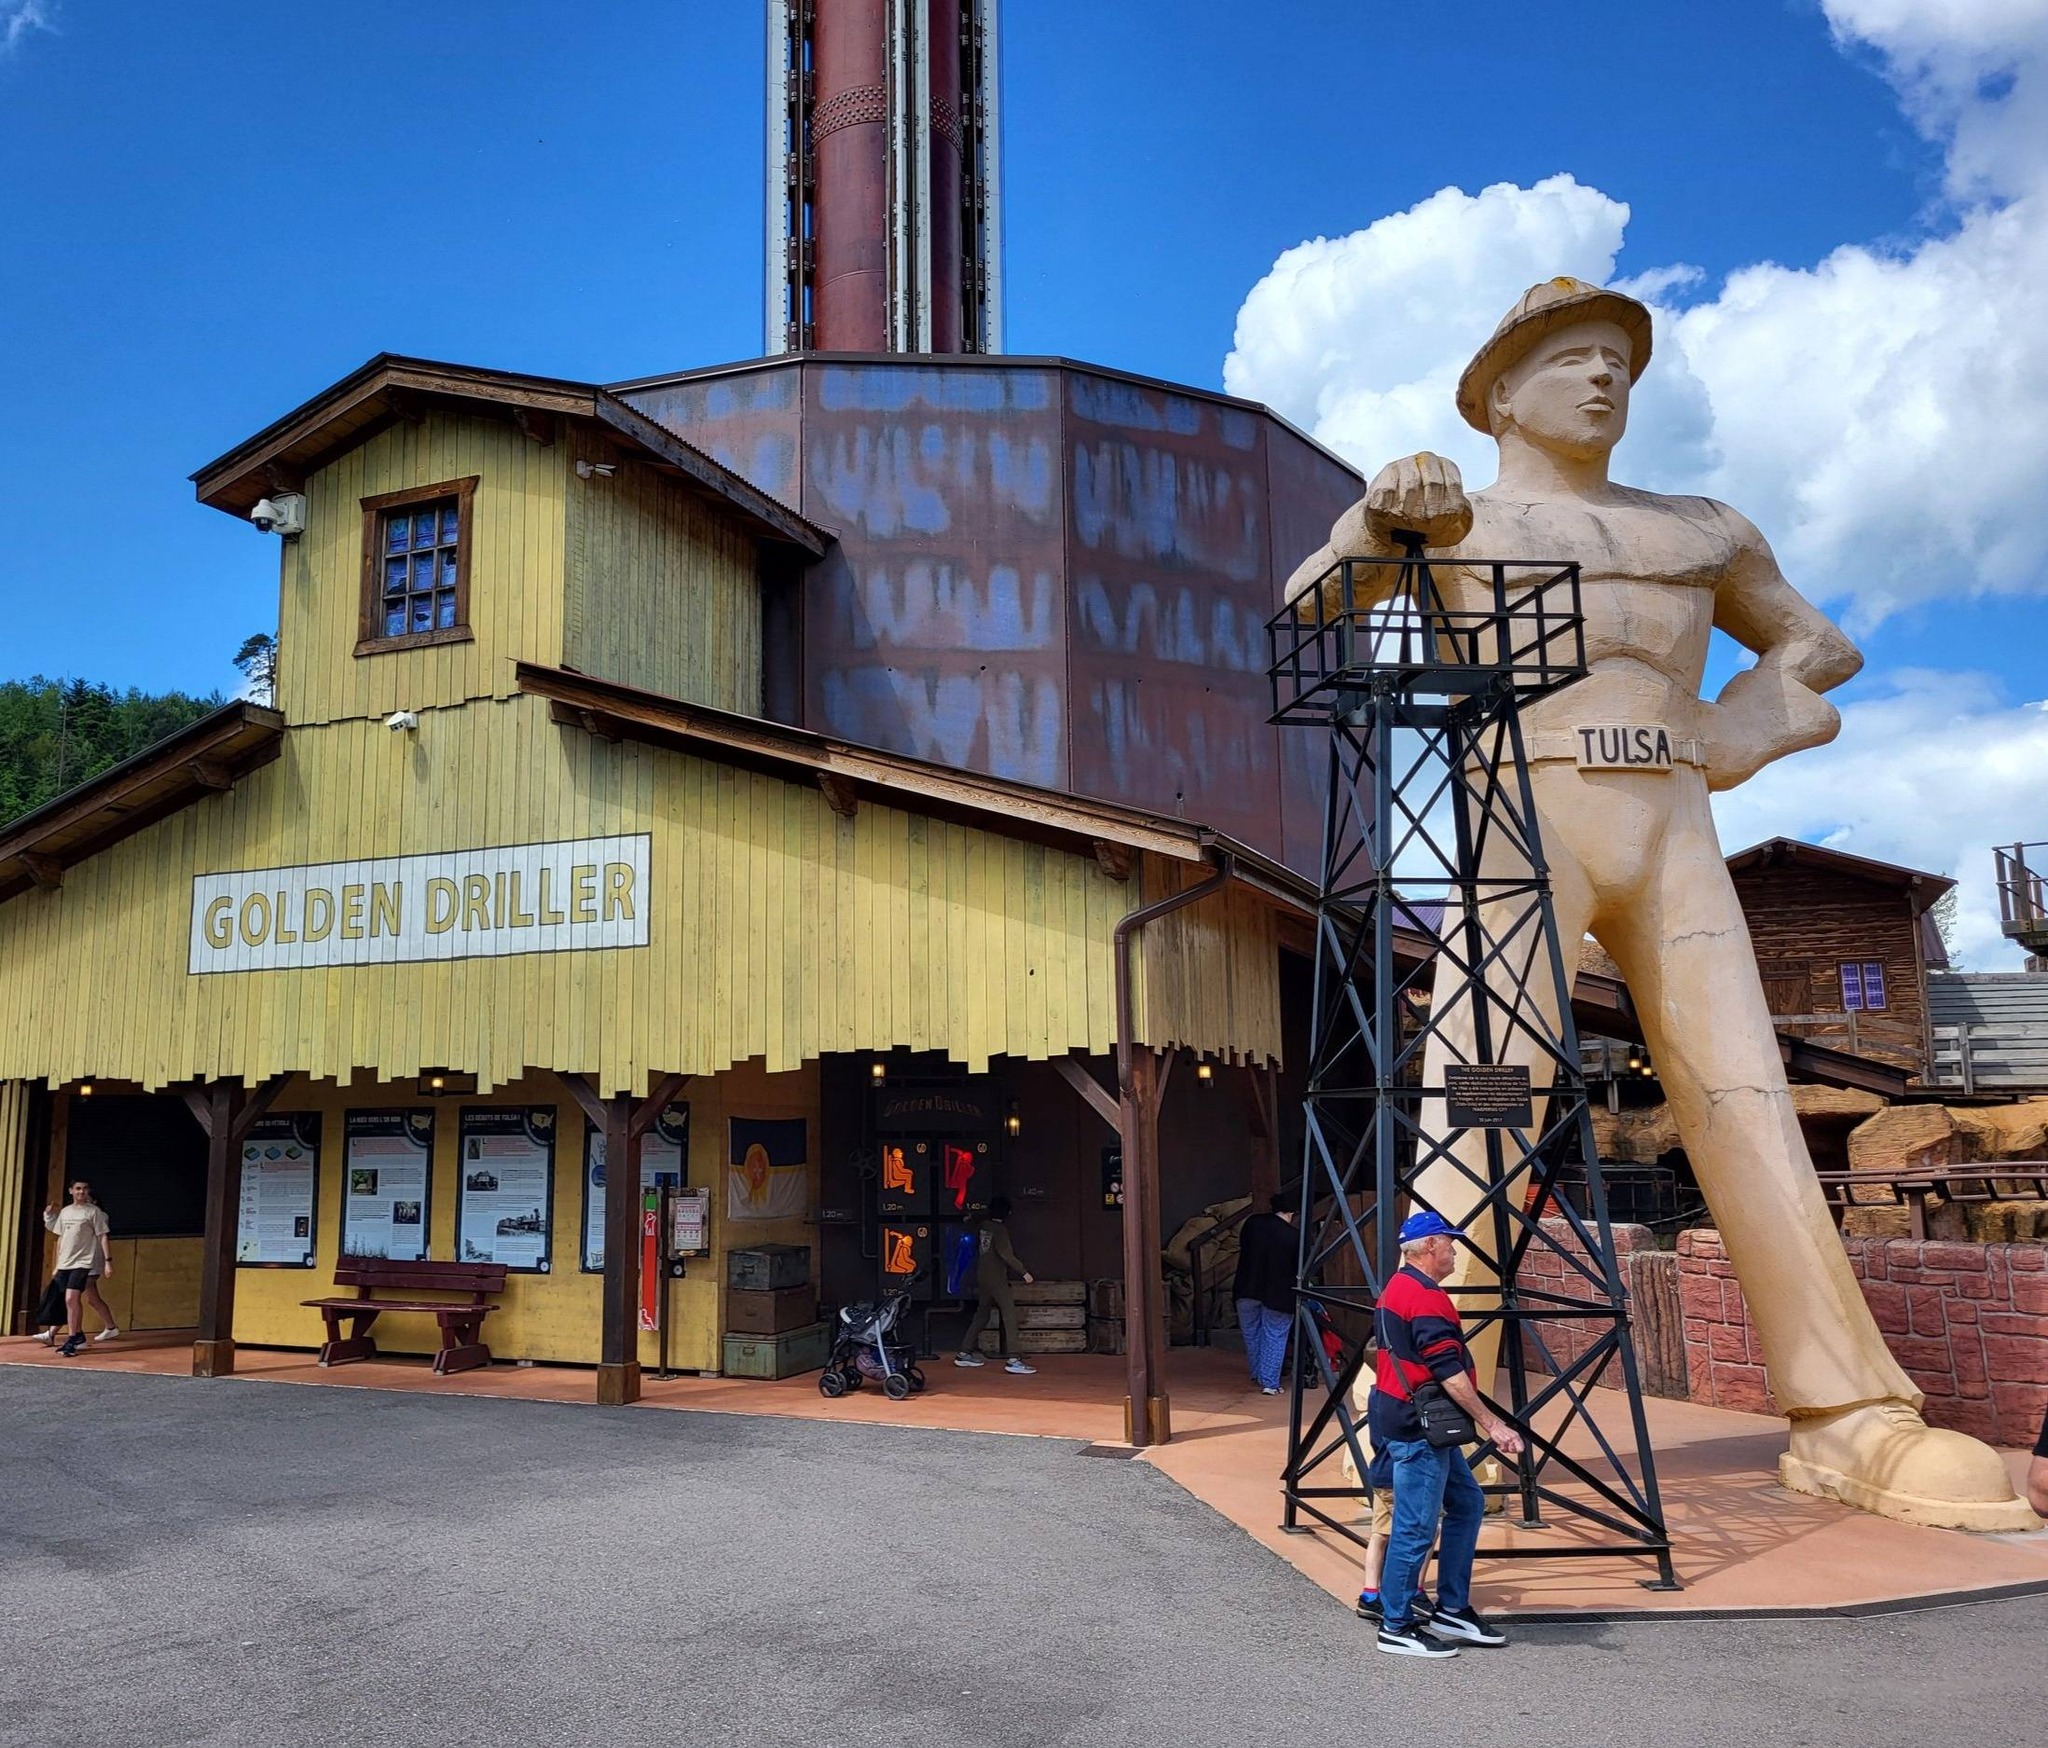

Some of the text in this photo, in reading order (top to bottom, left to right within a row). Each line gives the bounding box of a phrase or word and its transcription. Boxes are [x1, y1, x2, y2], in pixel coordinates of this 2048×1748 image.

[1578, 728, 1671, 765] TULSA
[204, 862, 635, 949] GOLDEN DRILLER
